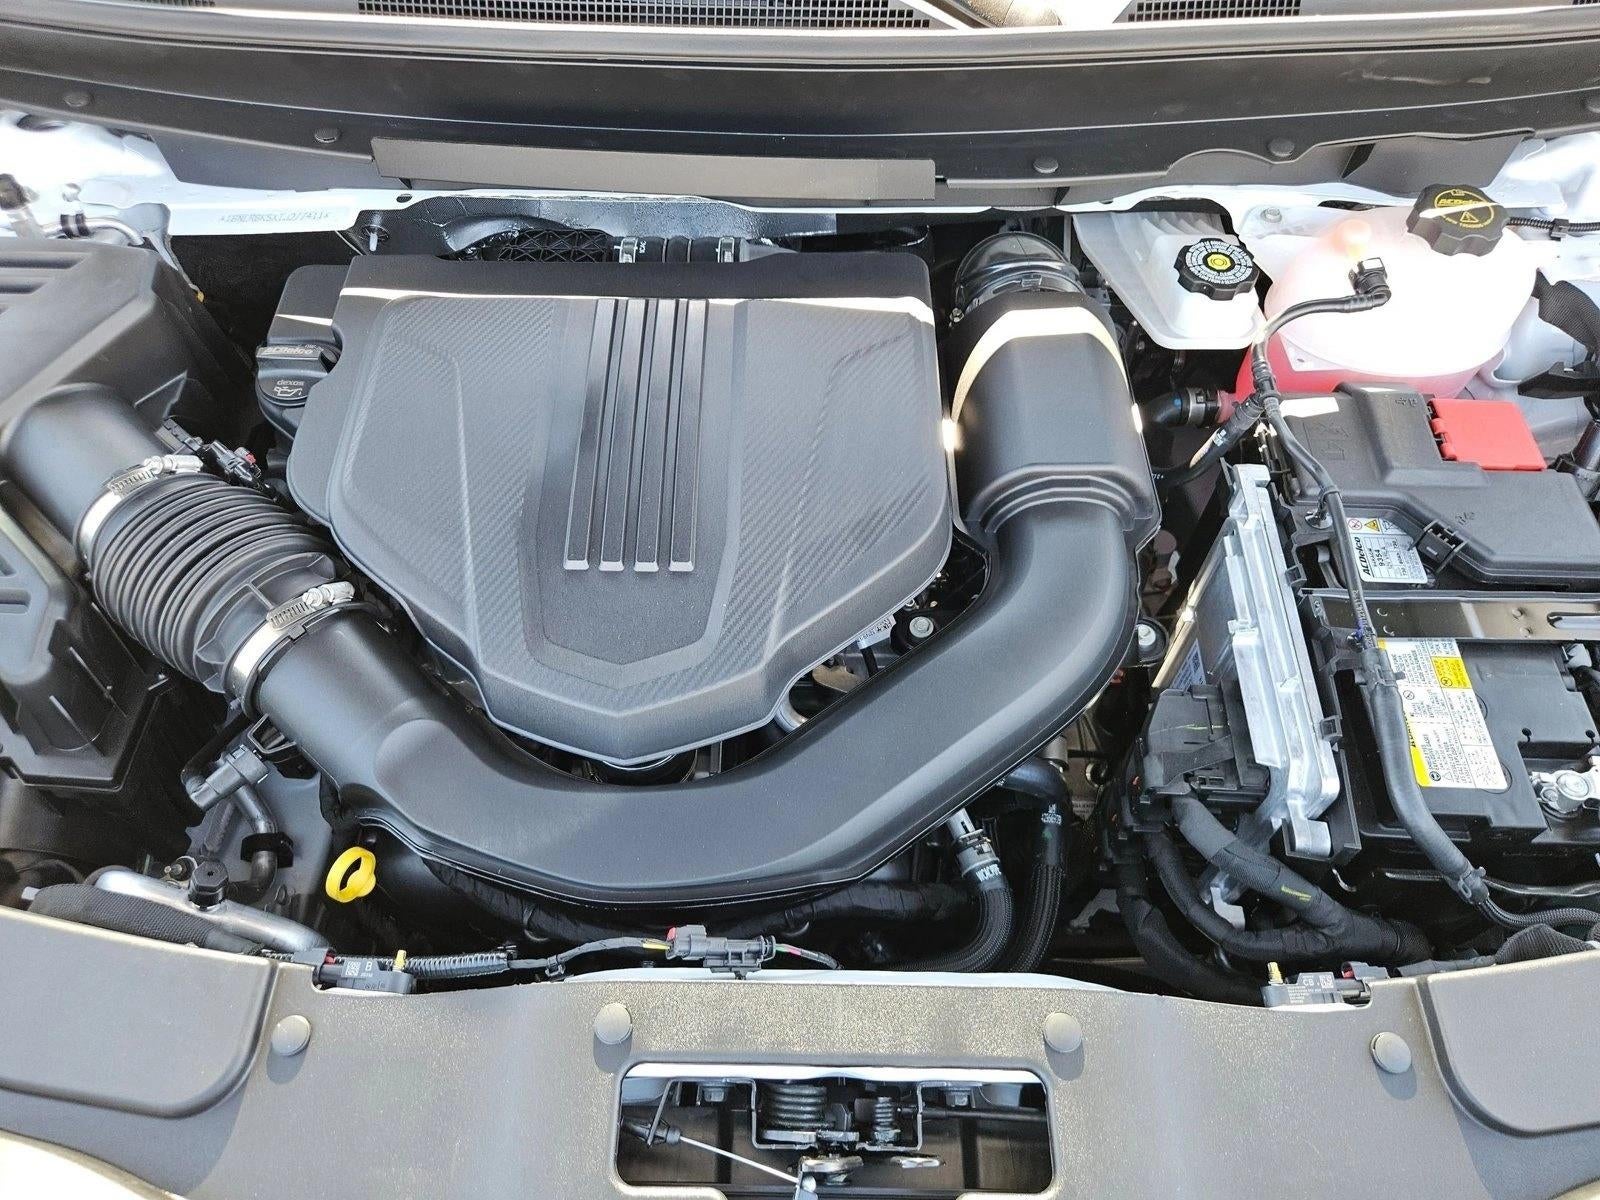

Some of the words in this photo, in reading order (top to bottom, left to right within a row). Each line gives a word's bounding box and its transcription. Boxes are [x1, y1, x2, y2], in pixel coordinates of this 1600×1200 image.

[261, 346, 313, 356] ACDelco
[1353, 536, 1371, 576] ACDelco
[365, 961, 373, 971] B
[1303, 978, 1315, 987] CB
